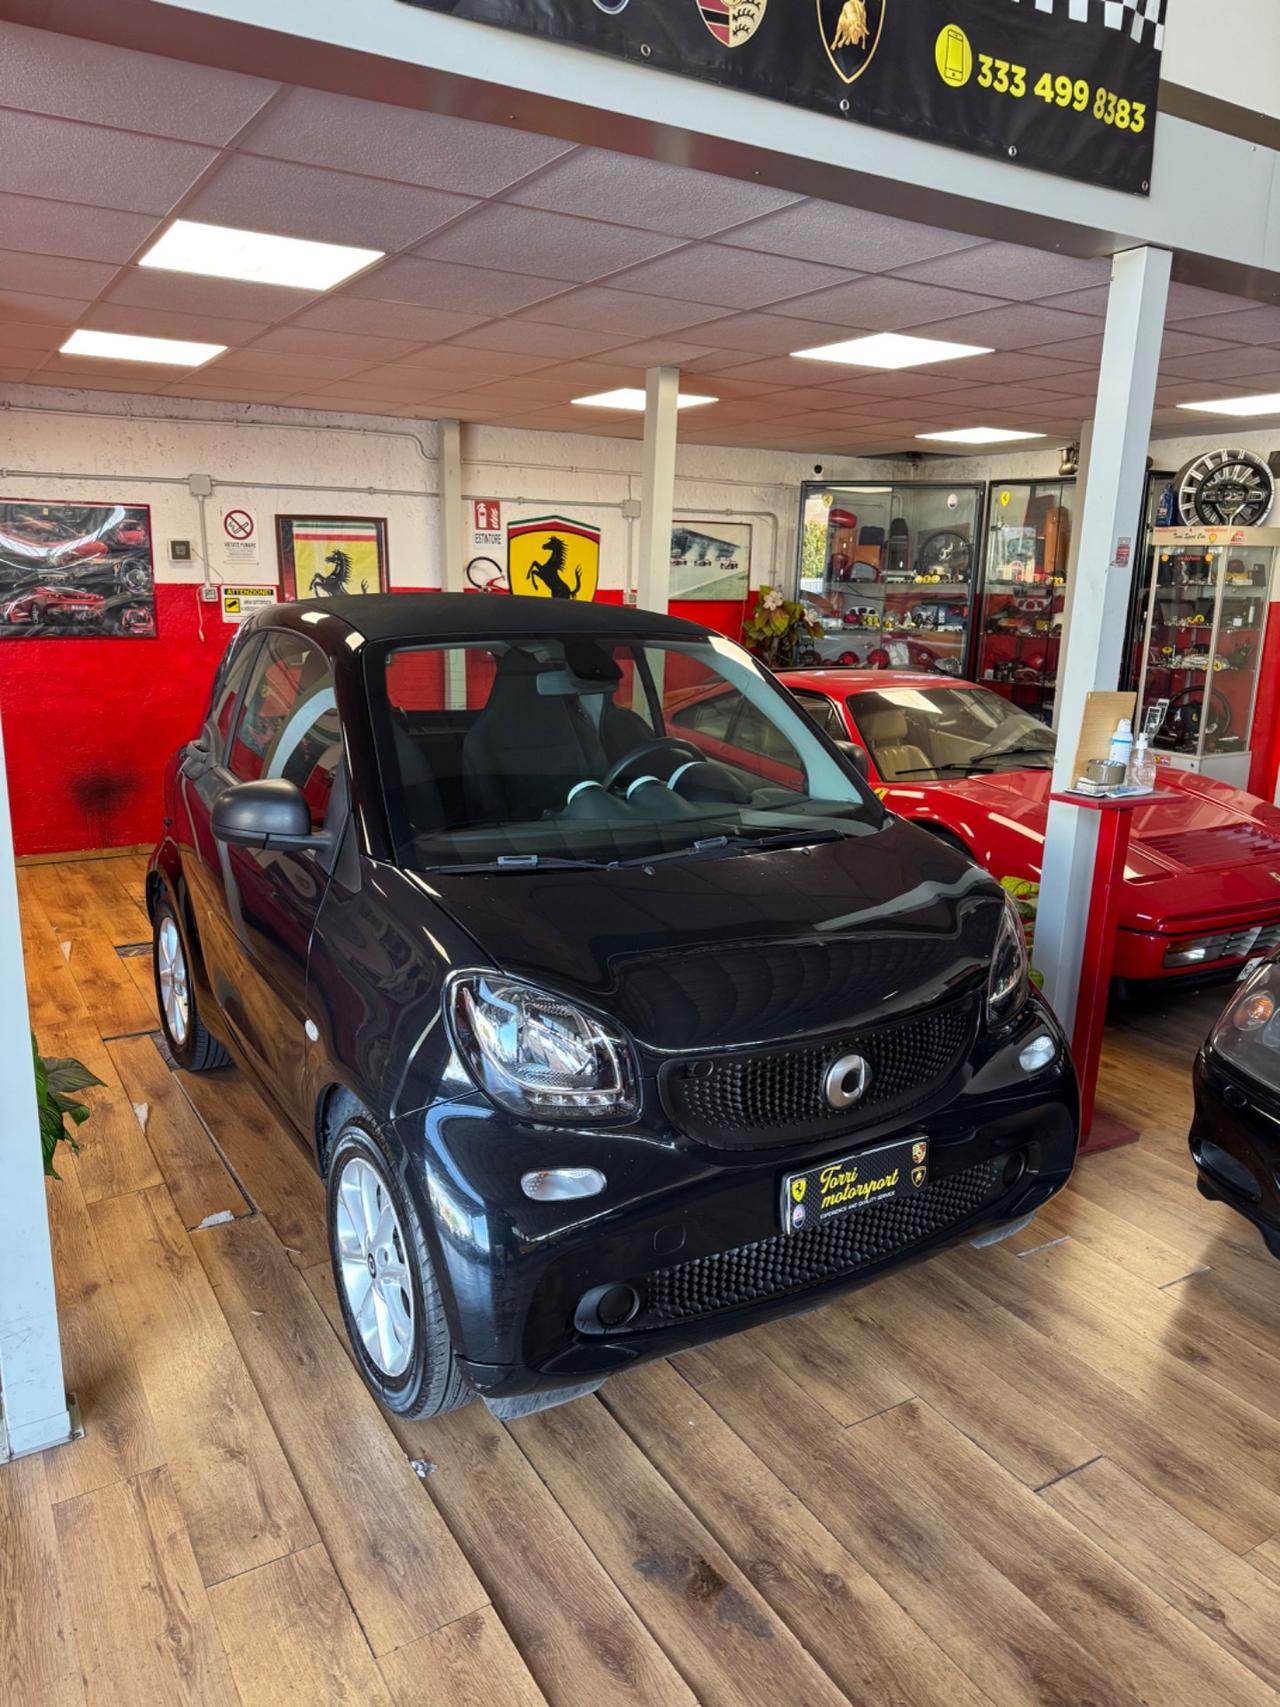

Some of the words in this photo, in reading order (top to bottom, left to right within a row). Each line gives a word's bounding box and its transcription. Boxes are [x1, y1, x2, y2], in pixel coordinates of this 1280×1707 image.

[977, 53, 1027, 97] 333
[1033, 73, 1090, 112] 499
[1093, 87, 1147, 133] 8383
[474, 532, 502, 545] ESTINTORE
[820, 1164, 858, 1194] Torri
[821, 1168, 899, 1208] motorsport
